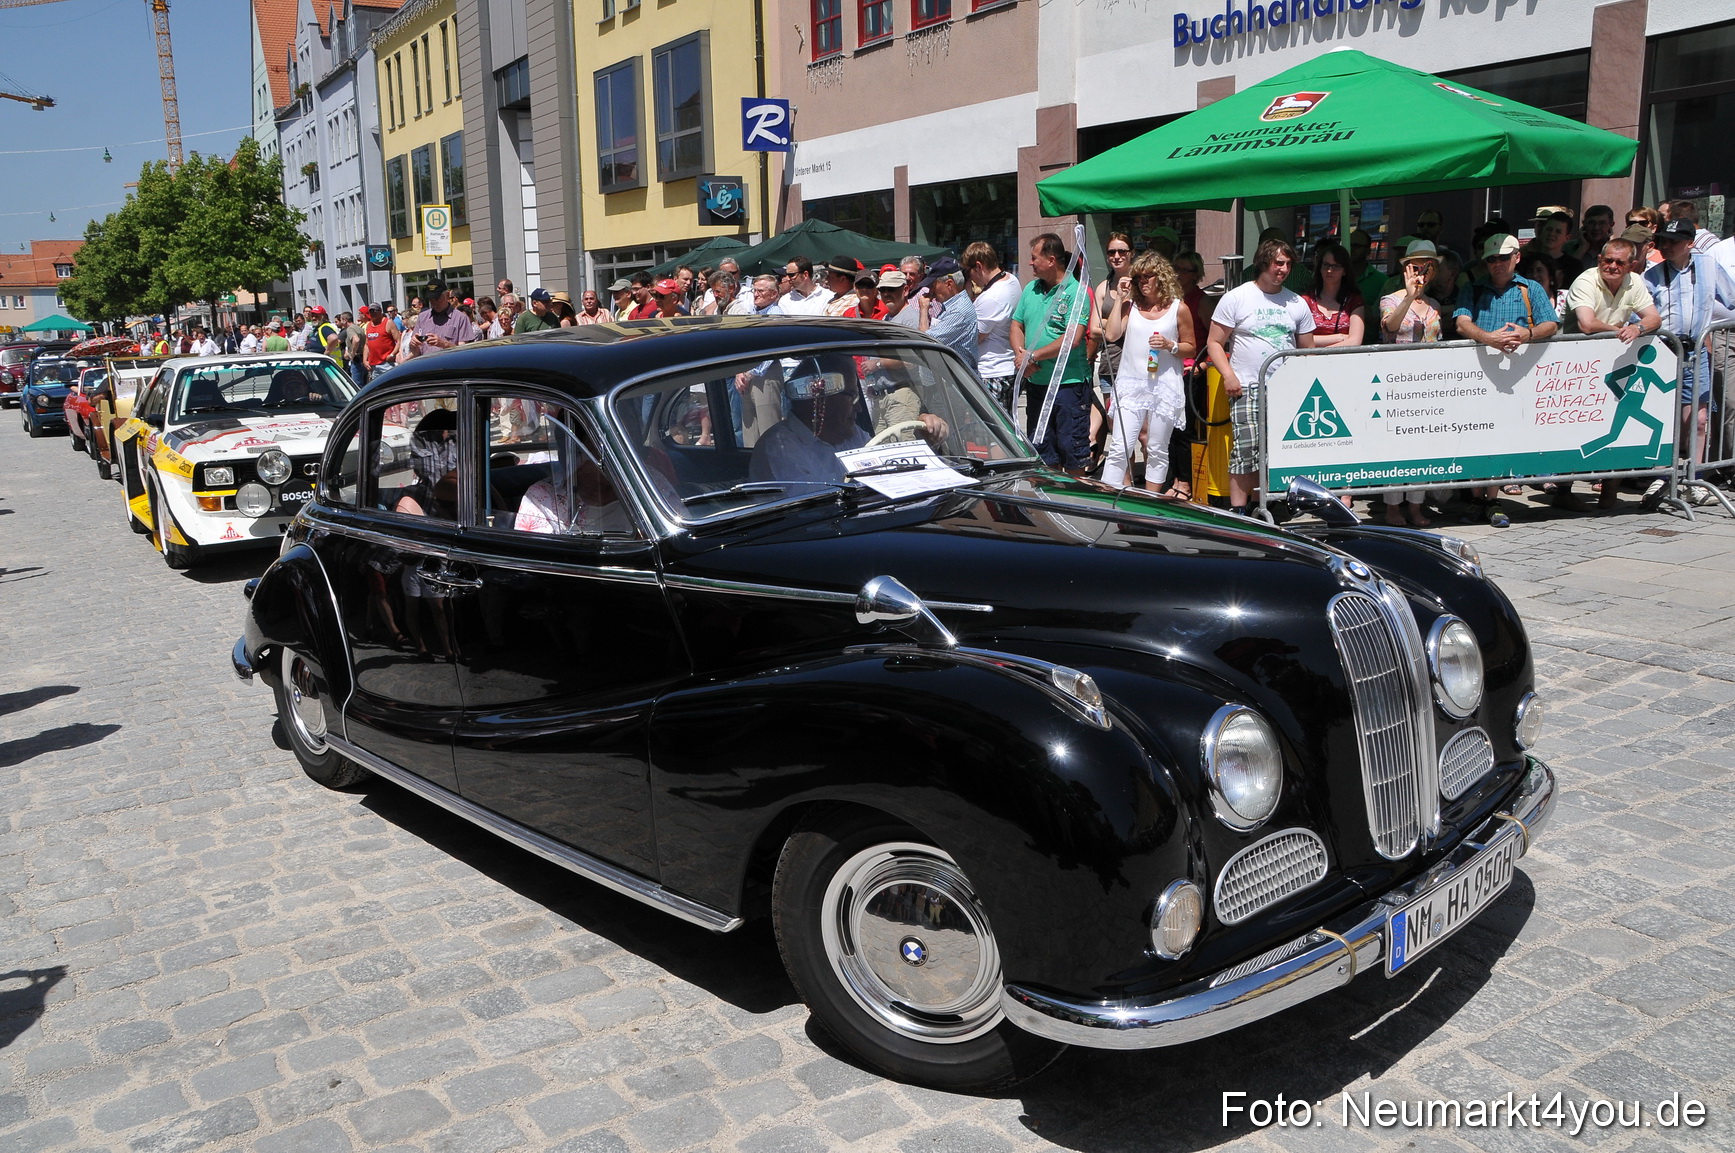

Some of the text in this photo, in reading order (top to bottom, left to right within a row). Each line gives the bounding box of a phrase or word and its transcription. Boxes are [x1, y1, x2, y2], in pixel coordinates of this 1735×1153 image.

[1204, 121, 1342, 142] Neumarkter
[1166, 130, 1358, 159] Lammsbräu
[795, 160, 832, 177] Unterer Markt 15
[716, 189, 733, 210] G2
[432, 213, 441, 225] H
[194, 365, 225, 374] HB
[1565, 360, 1601, 374] UNS
[1386, 370, 1484, 383] Gebäudereinigung
[1386, 387, 1487, 400] Hausmeisterdienste
[1386, 406, 1445, 418] Mietservice
[1535, 409, 1604, 425] BESSER.
[1395, 422, 1495, 435] Event-Leit-Systeme
[282, 491, 314, 501] BOSCH
[1406, 841, 1513, 953] NM HA 950H
[1395, 946, 1402, 958] D
